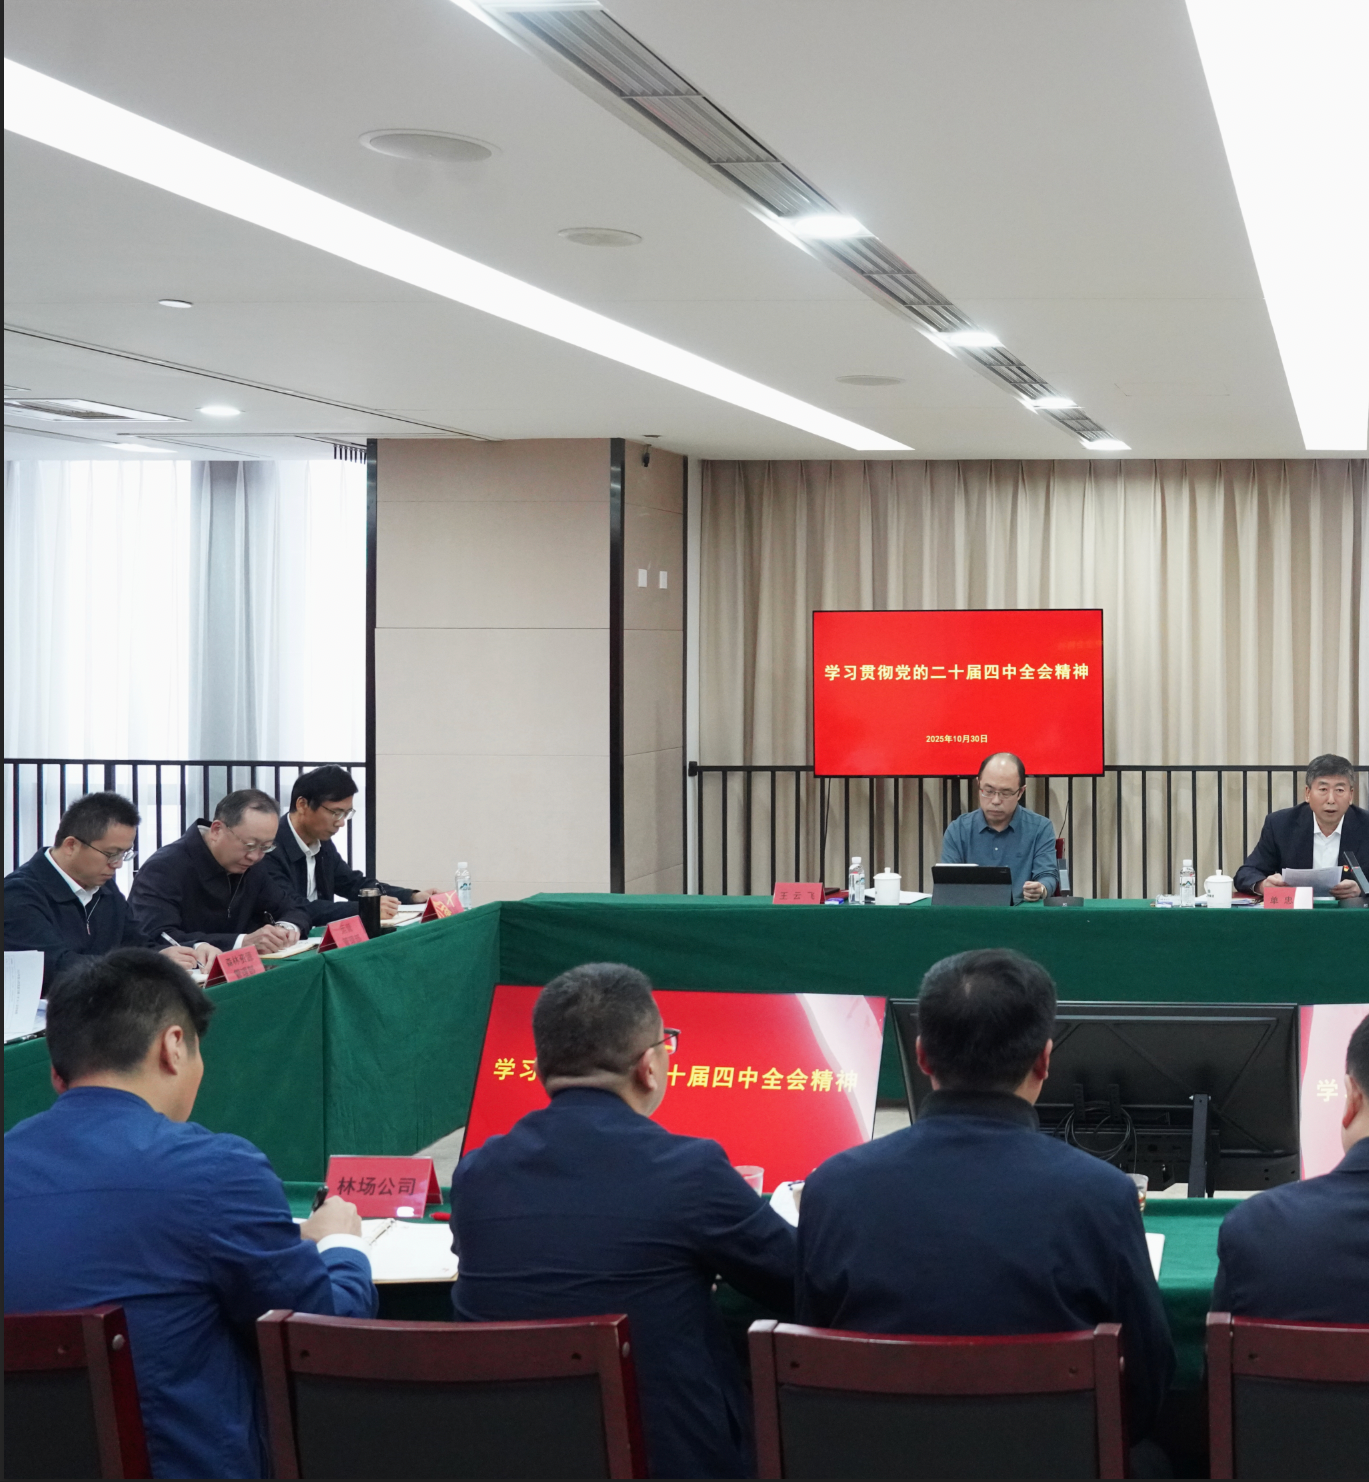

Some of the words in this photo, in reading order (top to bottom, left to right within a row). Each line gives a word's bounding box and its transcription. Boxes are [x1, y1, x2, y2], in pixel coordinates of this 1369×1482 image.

[824, 663, 1090, 681] 学习贯彻党的二十届四中全会精神
[926, 734, 988, 743] 2025年10月30日
[779, 891, 815, 900] 王云飞
[337, 1176, 416, 1196] 林场公司
